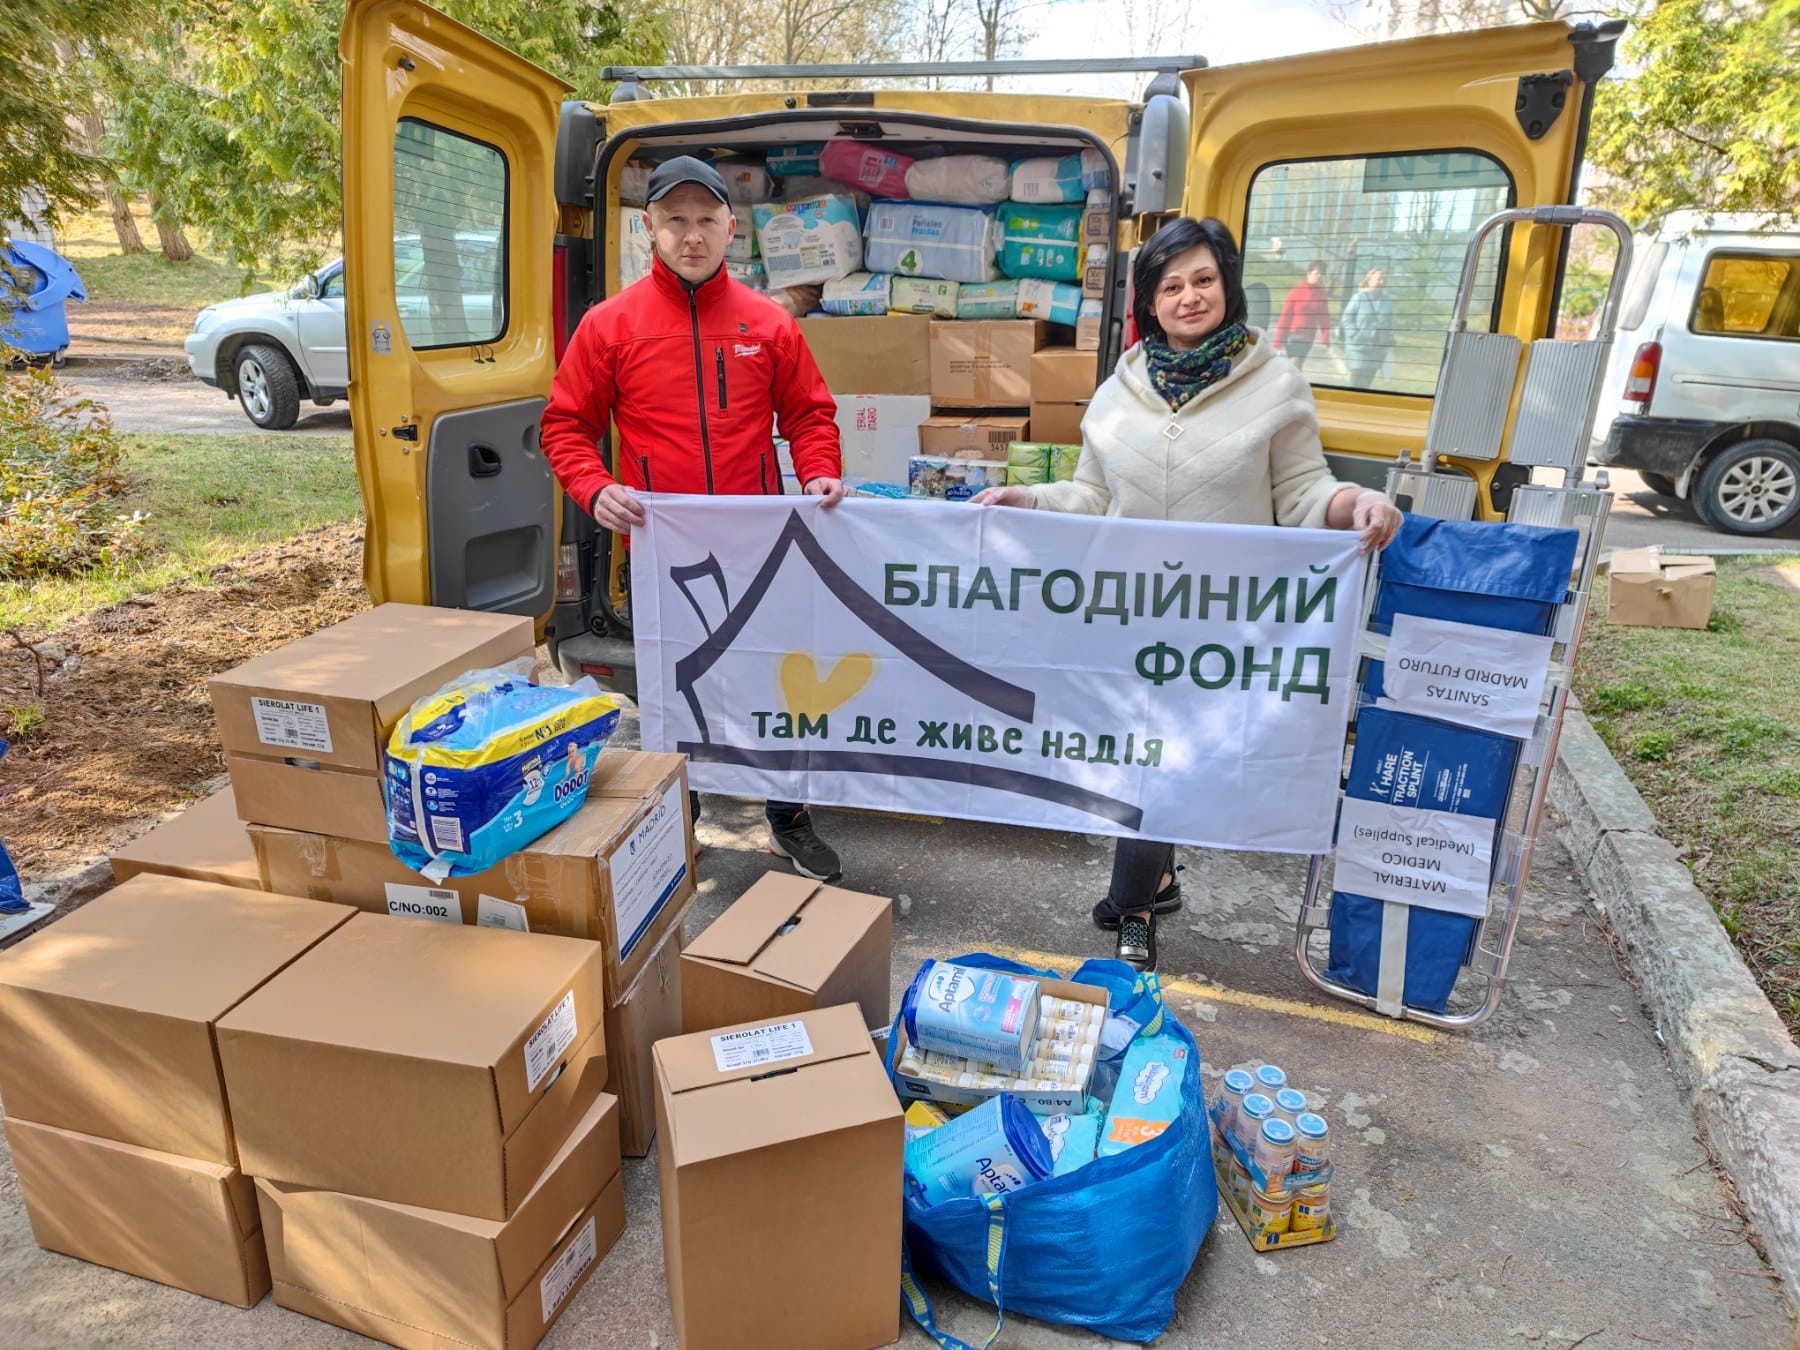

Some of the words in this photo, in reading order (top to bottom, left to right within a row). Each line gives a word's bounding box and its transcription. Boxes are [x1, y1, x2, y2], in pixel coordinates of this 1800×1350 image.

[901, 250, 917, 272] 4
[884, 560, 1338, 626] БЛАГОДІЙНИЙ
[1134, 641, 1331, 705] ФОНД
[1399, 657, 1461, 679] FUTURO
[1464, 667, 1528, 689] MADRID
[258, 699, 295, 710] SIEROLAT
[296, 704, 314, 713] LIFE
[1426, 684, 1490, 707] SANITAS
[751, 711, 829, 740] там
[846, 715, 897, 745] де
[916, 719, 1024, 756] живе
[1041, 725, 1165, 768] надія
[1381, 753, 1398, 786] HARE
[1393, 750, 1415, 803] TRACTION
[1406, 761, 1424, 798] SPLINT
[554, 770, 590, 802] DODOT
[513, 810, 523, 828] 3
[638, 804, 666, 844] MADRID
[1353, 824, 1413, 846] Supplies)
[1416, 837, 1475, 857] (Medical
[1381, 851, 1441, 872] MEDICO
[1373, 870, 1447, 893] MATERIAL
[389, 900, 448, 917] C/NO:002
[938, 966, 967, 1013] Aptamil
[720, 1028, 766, 1042] SIEROLAT
[769, 1024, 789, 1033] LIFE
